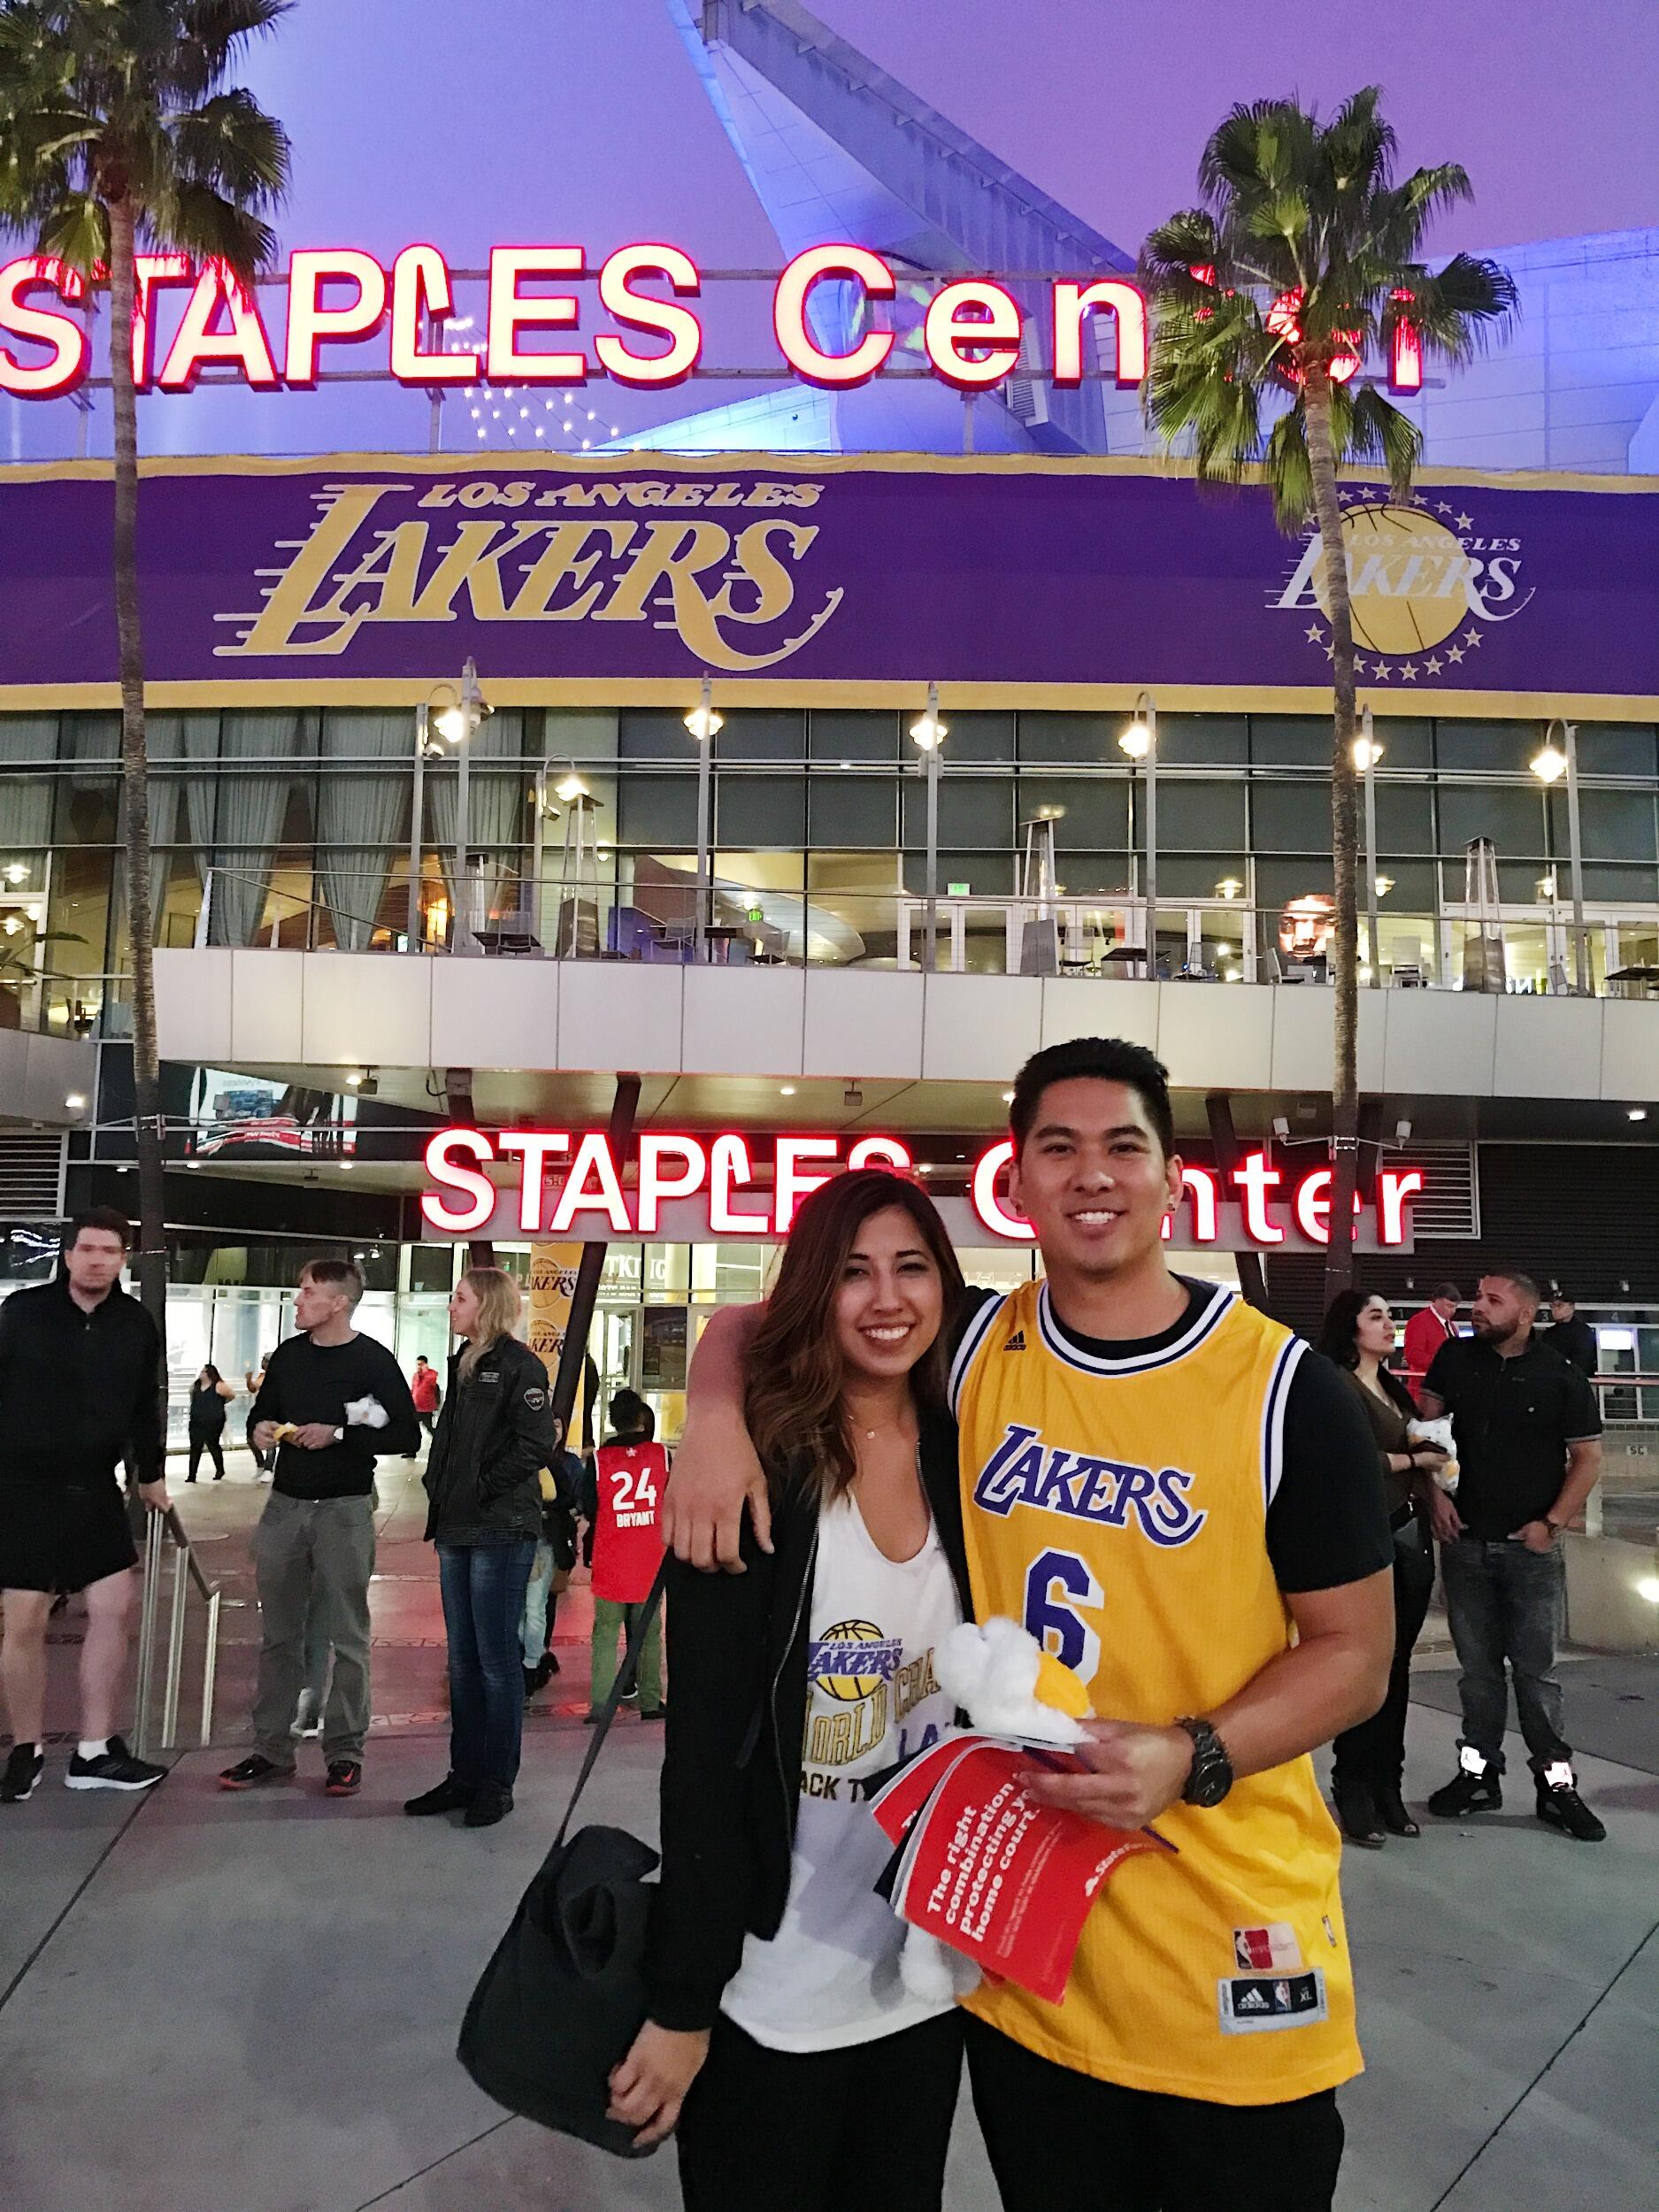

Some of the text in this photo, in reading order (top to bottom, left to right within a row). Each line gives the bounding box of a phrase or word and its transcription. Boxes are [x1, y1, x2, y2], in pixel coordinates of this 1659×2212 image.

[0, 243, 702, 398] STAPLES
[419, 482, 825, 508] LOS ANGELES
[1349, 533, 1522, 552] LOS ANGELES
[214, 483, 844, 672] LAKERS
[972, 1140, 1424, 1247] Cnter
[531, 1276, 578, 1298] KERS
[1542, 1310, 1549, 1322] 3
[611, 1467, 657, 1511] 24
[974, 1423, 1209, 1548] LAKERS
[616, 1510, 655, 1528] BRYANT
[1023, 1546, 1104, 1686] 6
[829, 1639, 902, 1651] LOS ANGELES
[895, 1647, 942, 1724] CHA
[927, 1805, 977, 1913] The right
[945, 1783, 1015, 1924] combination
[959, 1809, 1018, 1936] protecting
[1094, 1846, 1125, 1877] State
[971, 1874, 1003, 1942] home
[1237, 2001, 1271, 2010] adidas
[1299, 1990, 1314, 2003] XL
